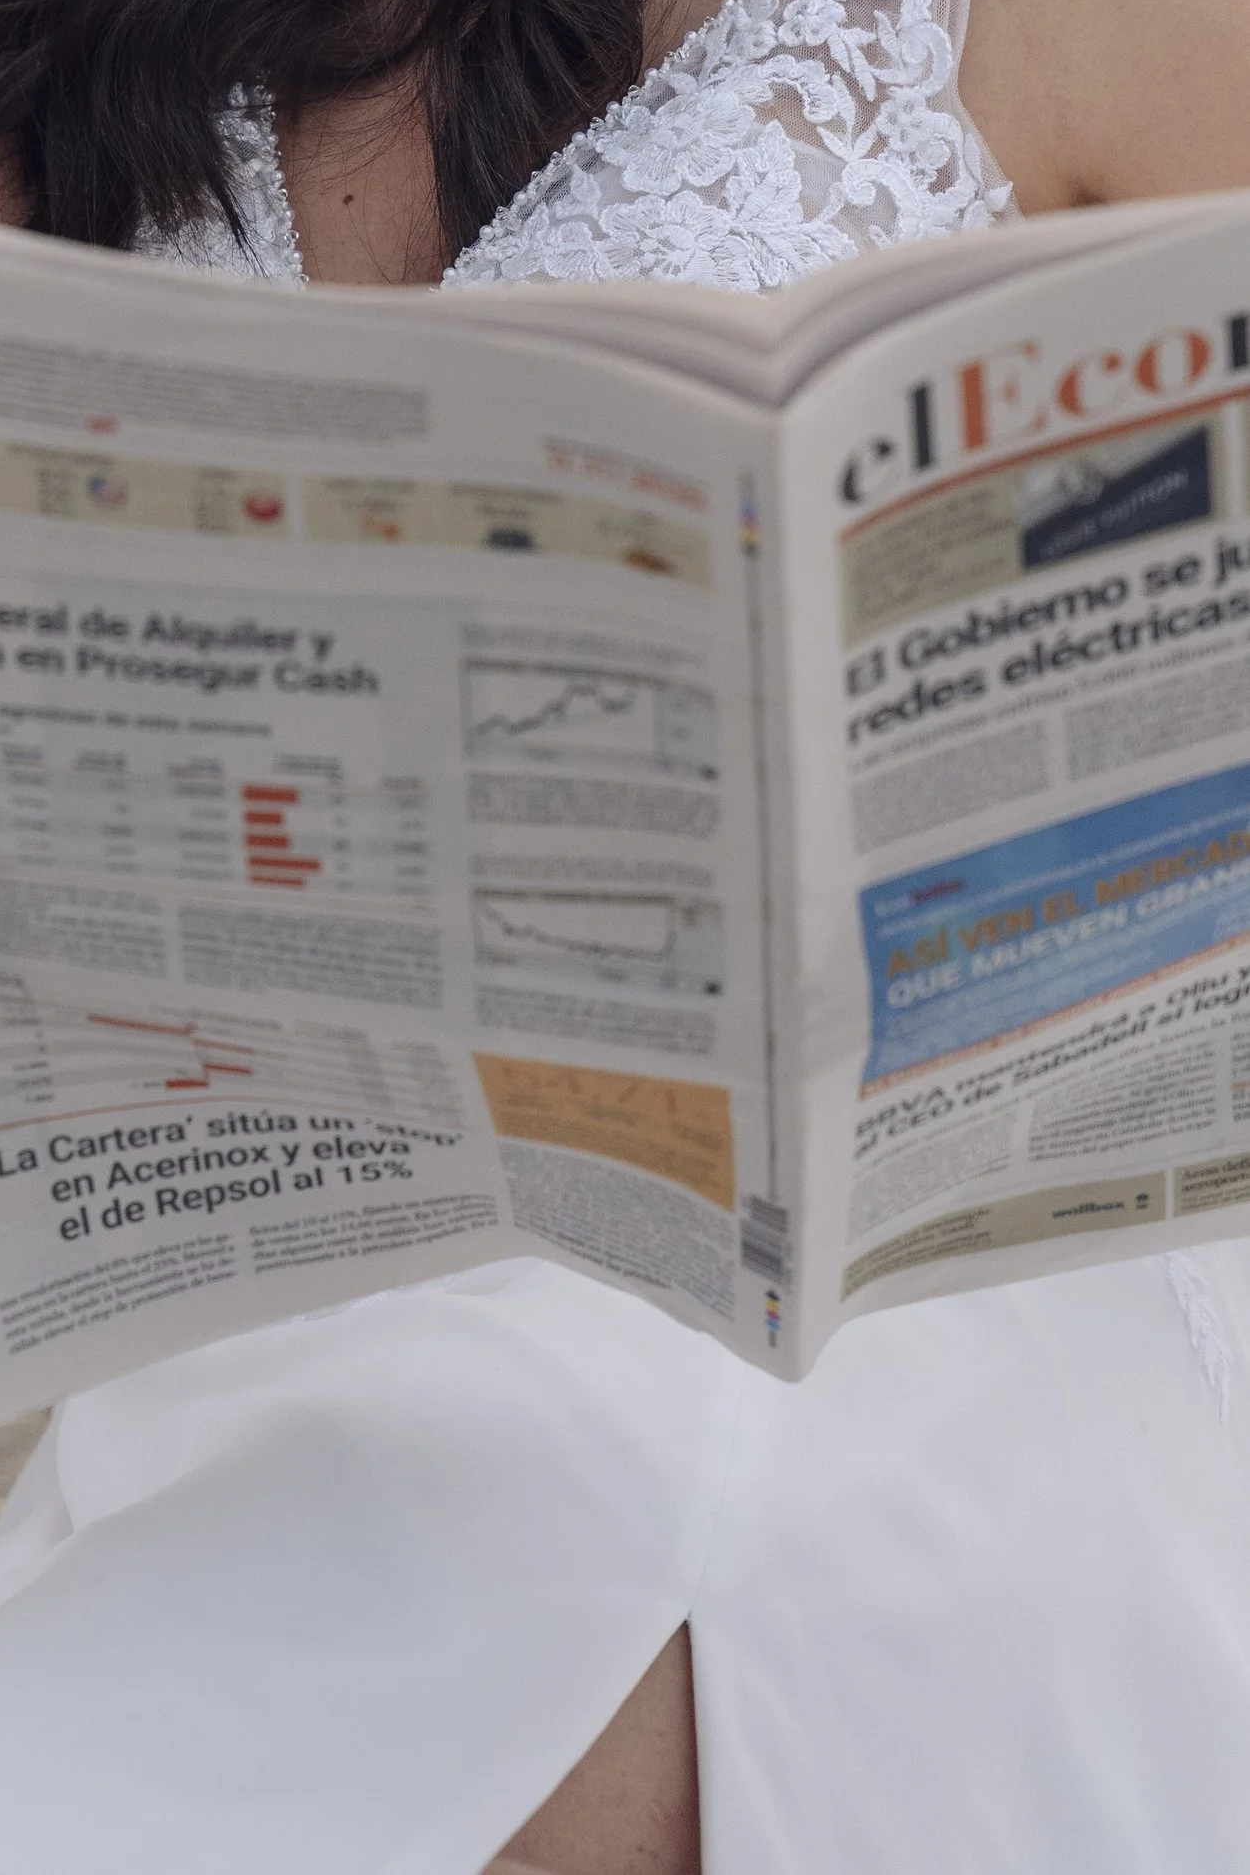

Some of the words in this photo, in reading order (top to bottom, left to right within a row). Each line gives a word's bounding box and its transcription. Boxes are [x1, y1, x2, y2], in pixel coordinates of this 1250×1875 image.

[79, 605, 128, 640] de
[141, 610, 298, 657] Alquiler
[311, 627, 335, 661] y
[897, 573, 1130, 674] Gobierno
[1141, 549, 1202, 597] se
[15, 641, 65, 674] en
[76, 647, 260, 695] Prosegur
[275, 656, 381, 699] Cash
[846, 666, 987, 747] redes
[999, 593, 1250, 689] eléctricas
[1042, 890, 1085, 925] EL
[46, 1112, 196, 1167] Cartera'
[206, 1109, 299, 1137] sitúa
[49, 1169, 98, 1205] en
[105, 1139, 270, 1194] Acerinox
[280, 1142, 312, 1169] y
[312, 1135, 412, 1162] eleva
[58, 1203, 91, 1243] el
[100, 1193, 148, 1235] de
[154, 1167, 283, 1217] Repsol
[293, 1166, 326, 1194] al
[340, 1160, 414, 1187] 15%
